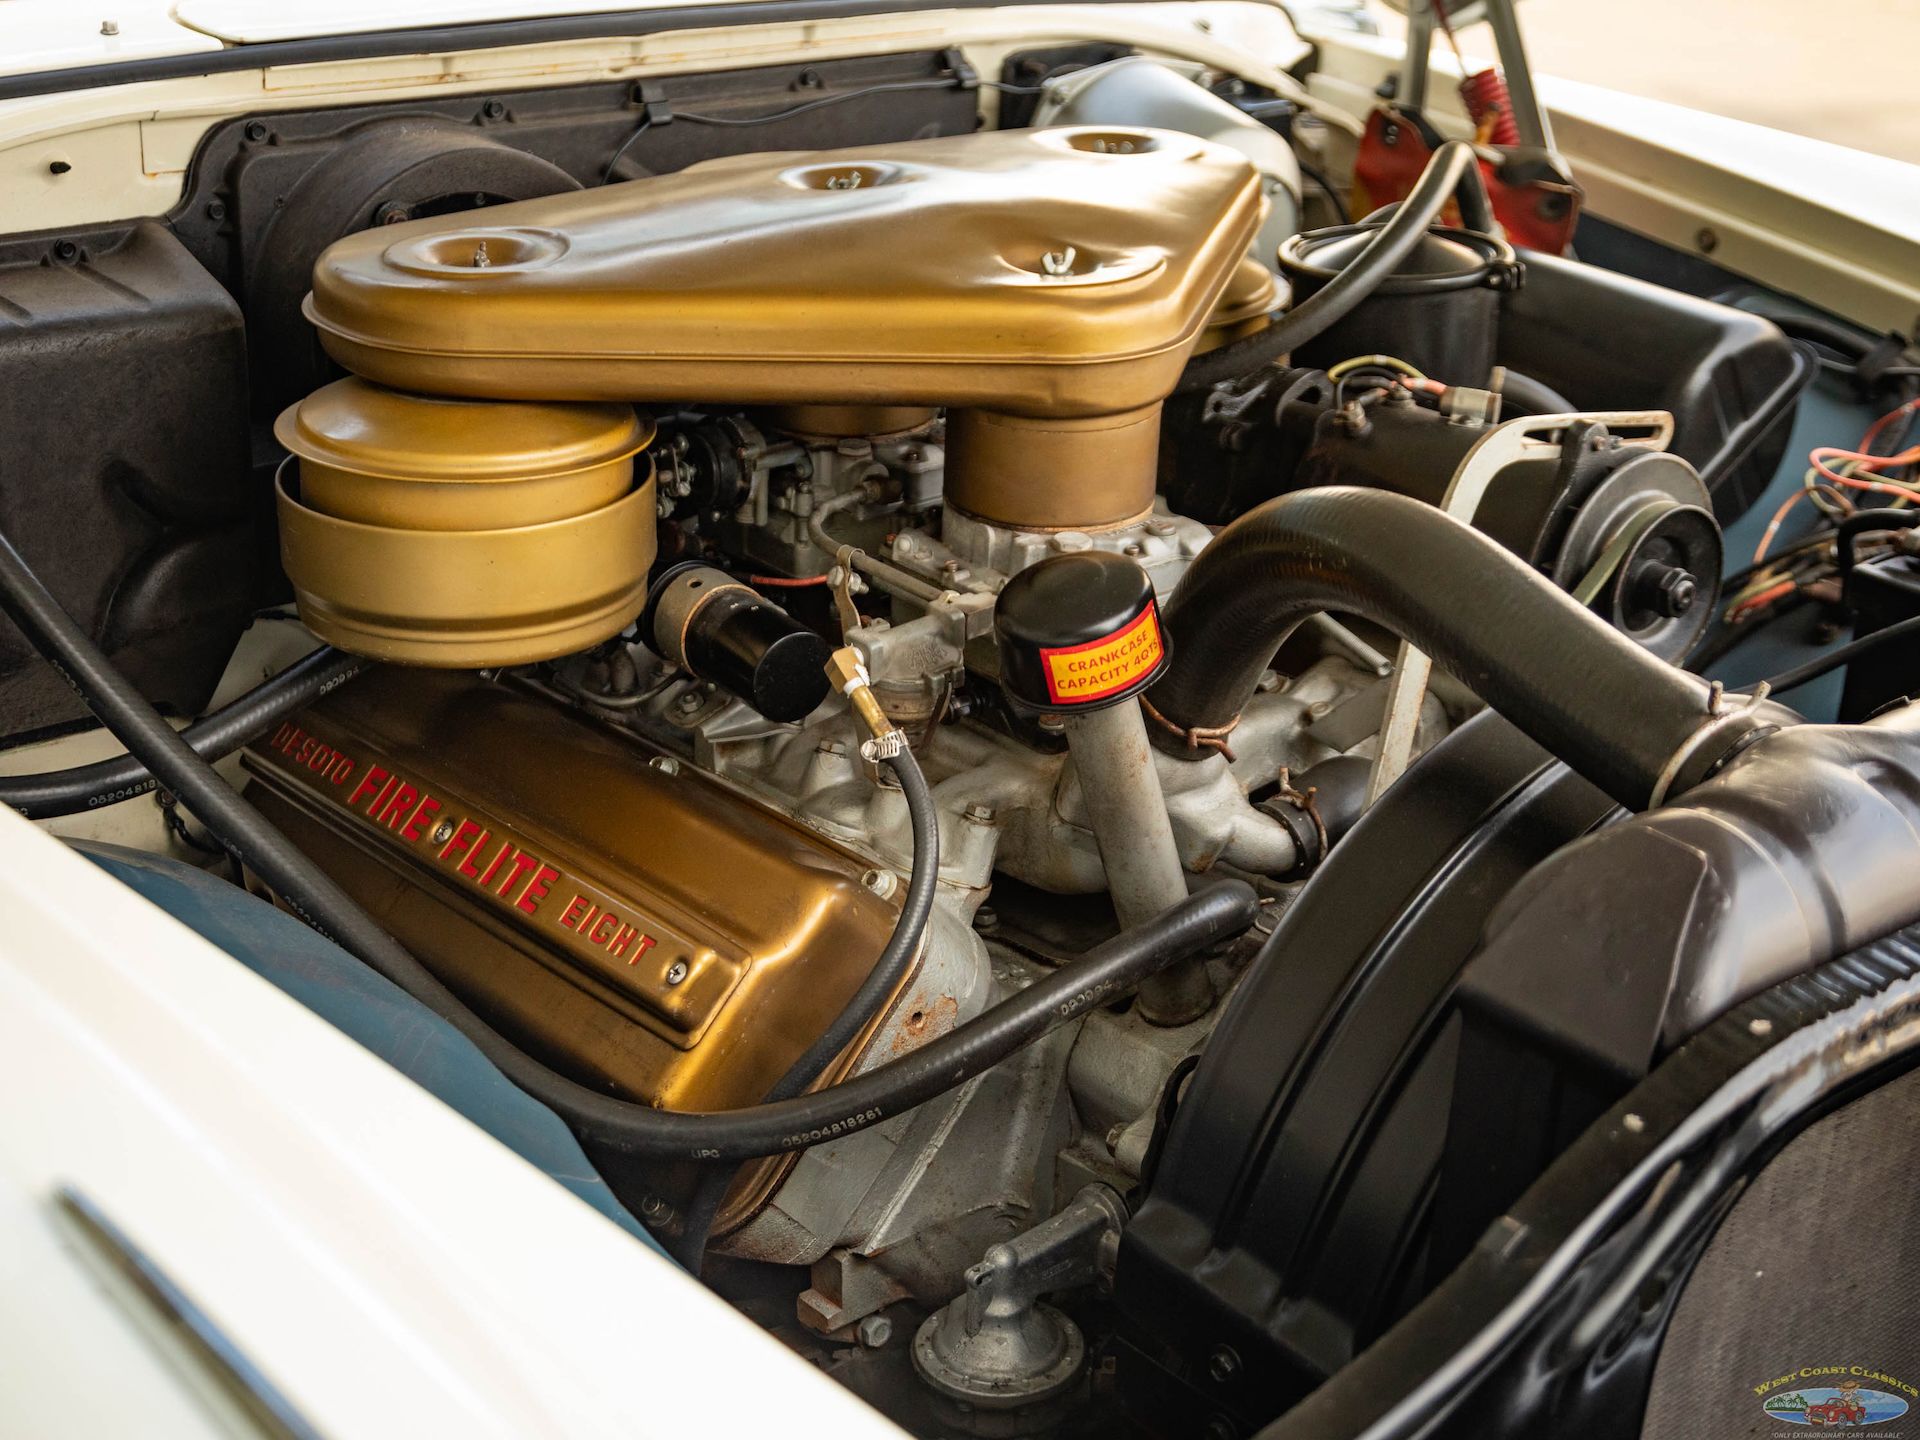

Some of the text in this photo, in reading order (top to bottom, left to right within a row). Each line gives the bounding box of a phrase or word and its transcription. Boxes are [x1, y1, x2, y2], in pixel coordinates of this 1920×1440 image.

[1057, 638, 1158, 690] CAPACITY 4QTS
[1068, 630, 1148, 673] CRANKCASE
[88, 779, 161, 807] 05204818
[271, 721, 657, 967] DESOTO FIRE FLITE EIGHT
